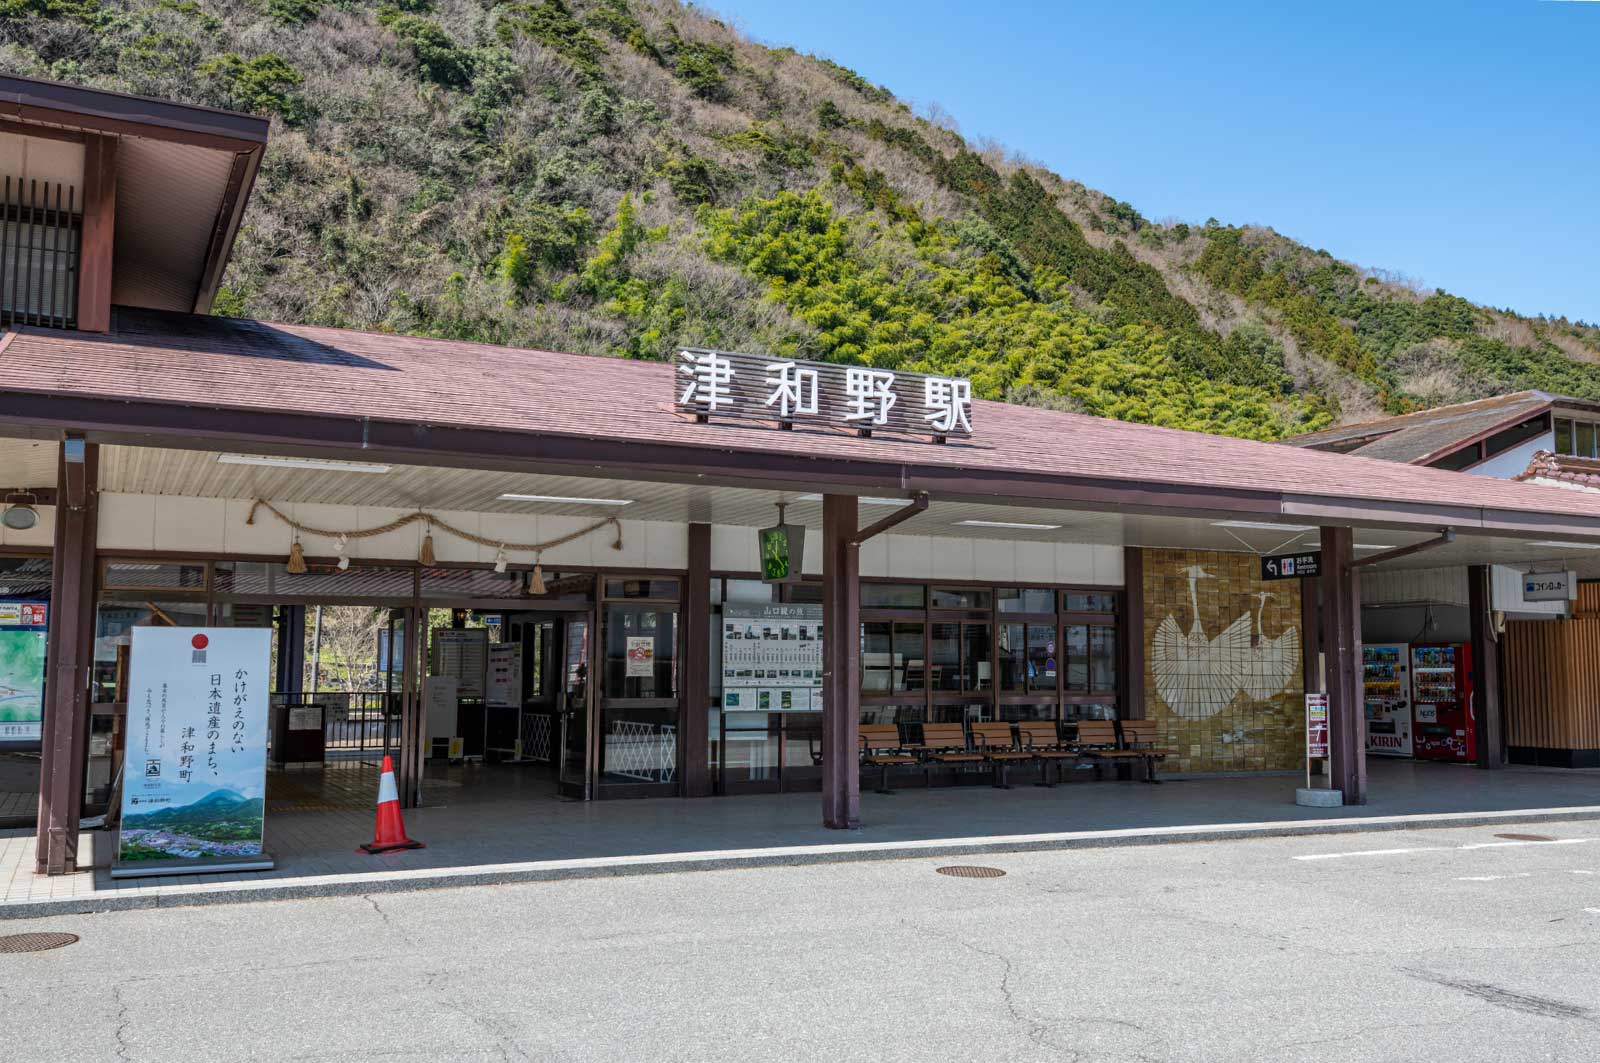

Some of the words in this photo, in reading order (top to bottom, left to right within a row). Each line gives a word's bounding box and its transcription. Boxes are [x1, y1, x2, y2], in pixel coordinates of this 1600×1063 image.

[679, 350, 973, 433] 津和野駅
[231, 668, 248, 753] かけがえのない
[1370, 736, 1403, 748] KIRIN
[179, 726, 195, 783] 津和野町
